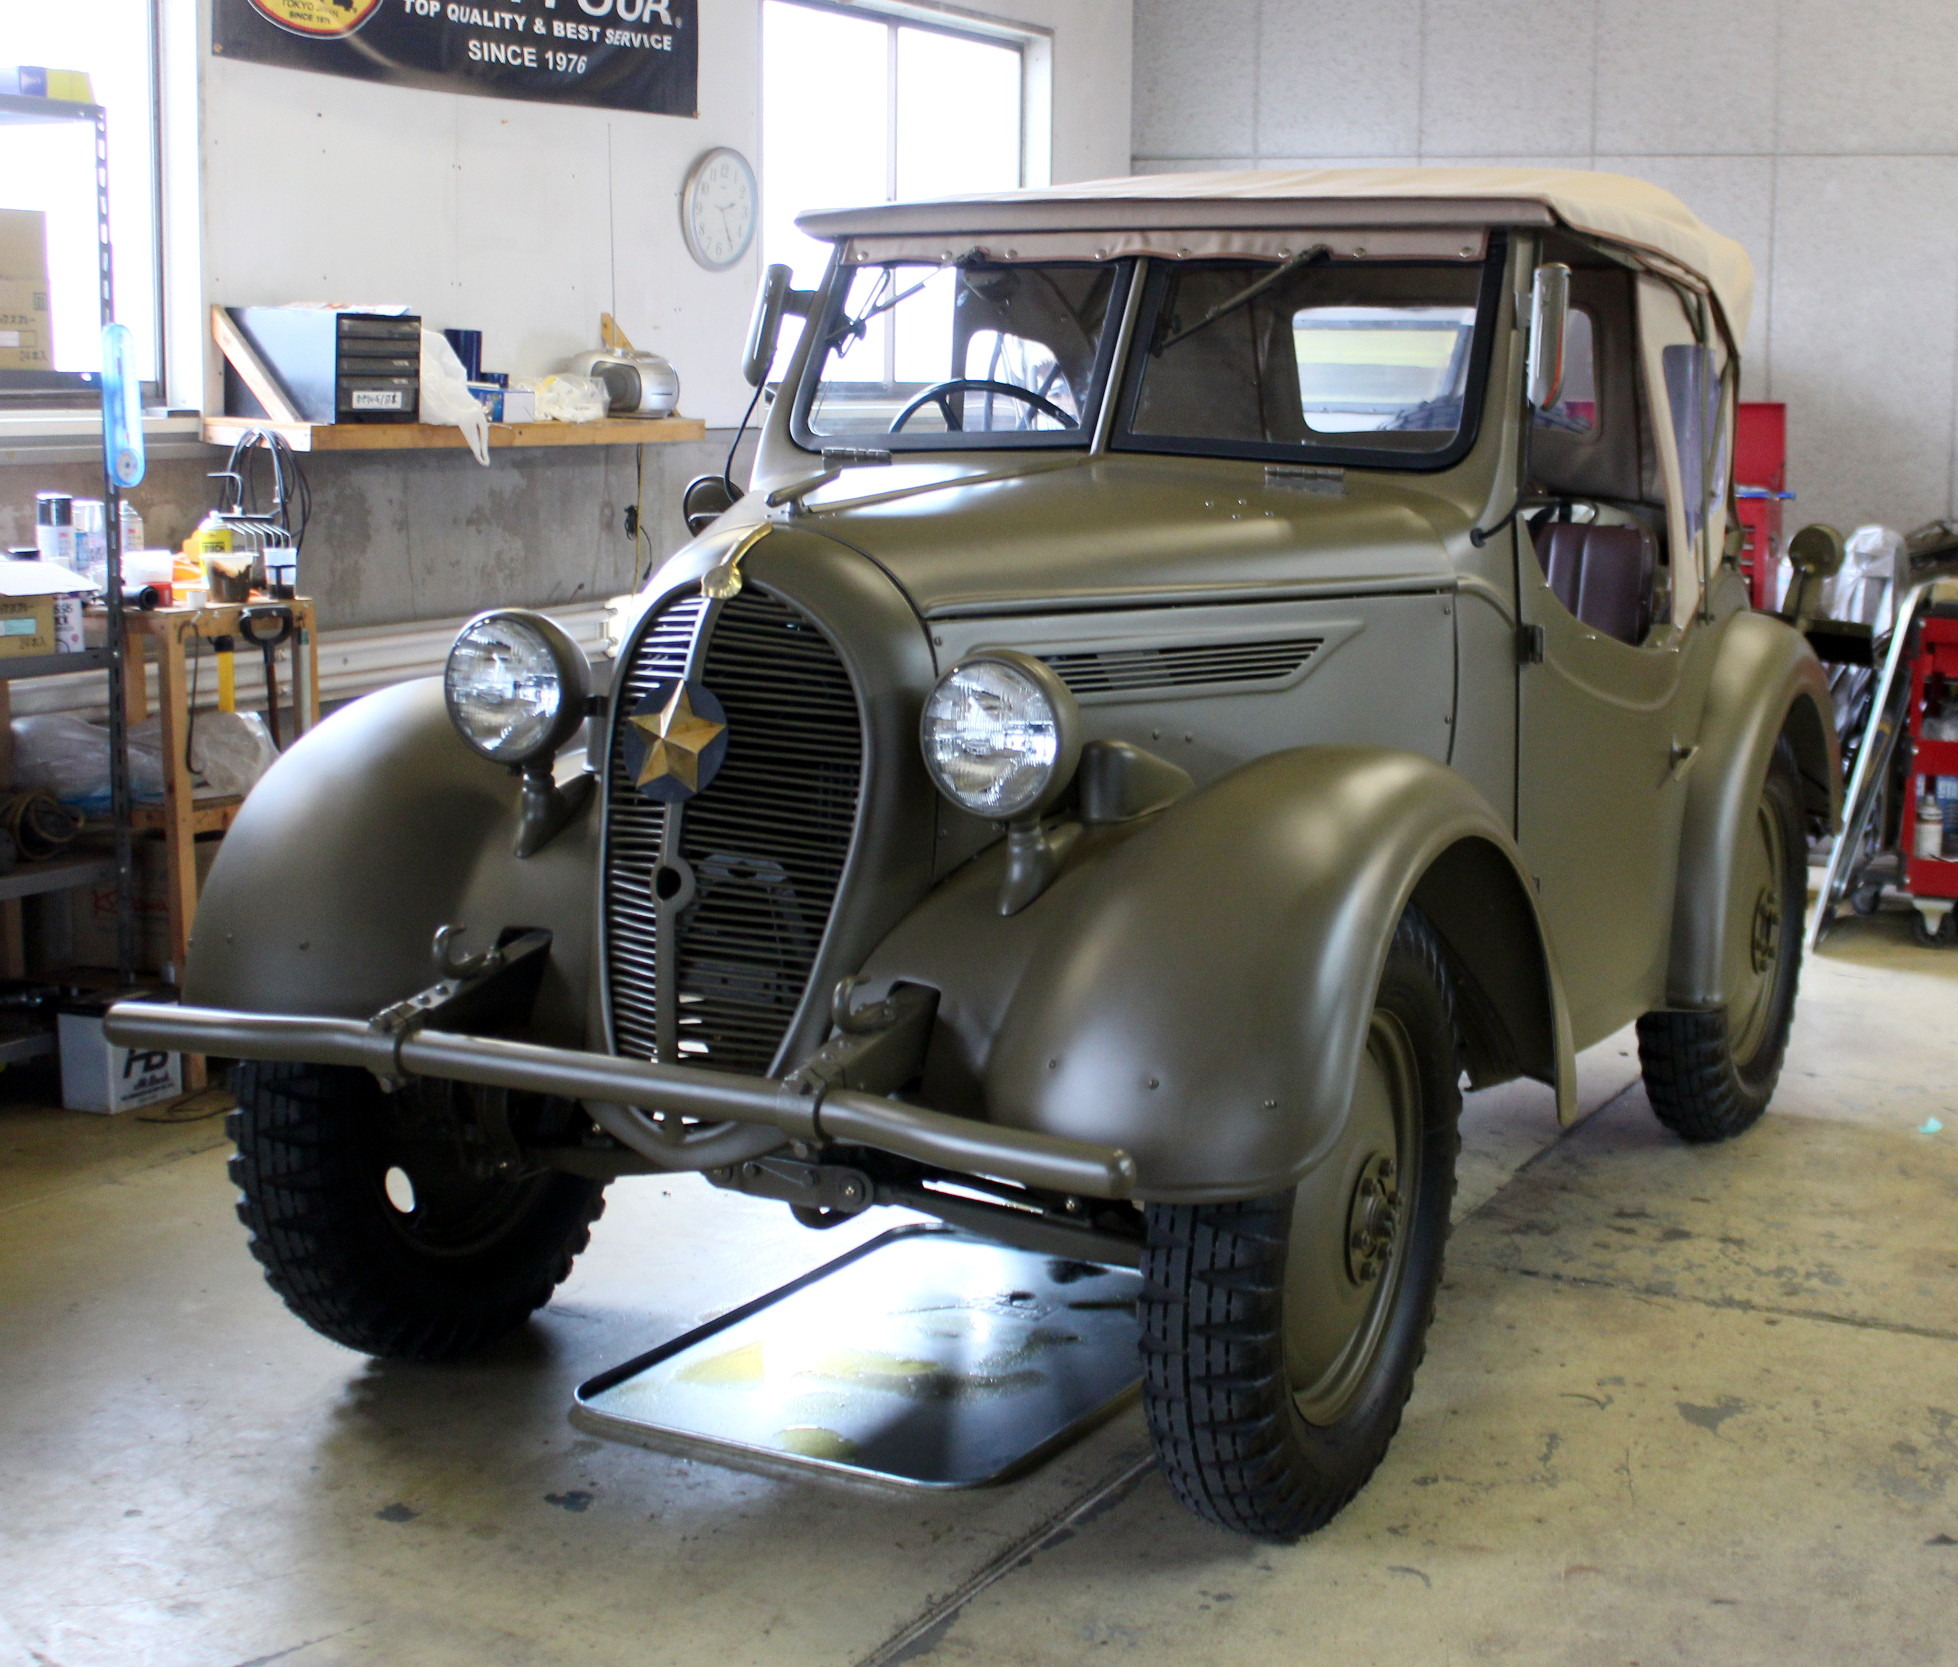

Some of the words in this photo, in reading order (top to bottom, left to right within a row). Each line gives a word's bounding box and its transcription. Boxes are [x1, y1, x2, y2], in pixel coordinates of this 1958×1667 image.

[403, 0, 441, 17] TOP
[446, 3, 526, 31] QUALITY
[533, 17, 547, 35] &
[552, 20, 600, 42] BEST
[604, 28, 672, 51] SERVICE
[467, 39, 538, 68] SINCE
[544, 50, 588, 74] 1976
